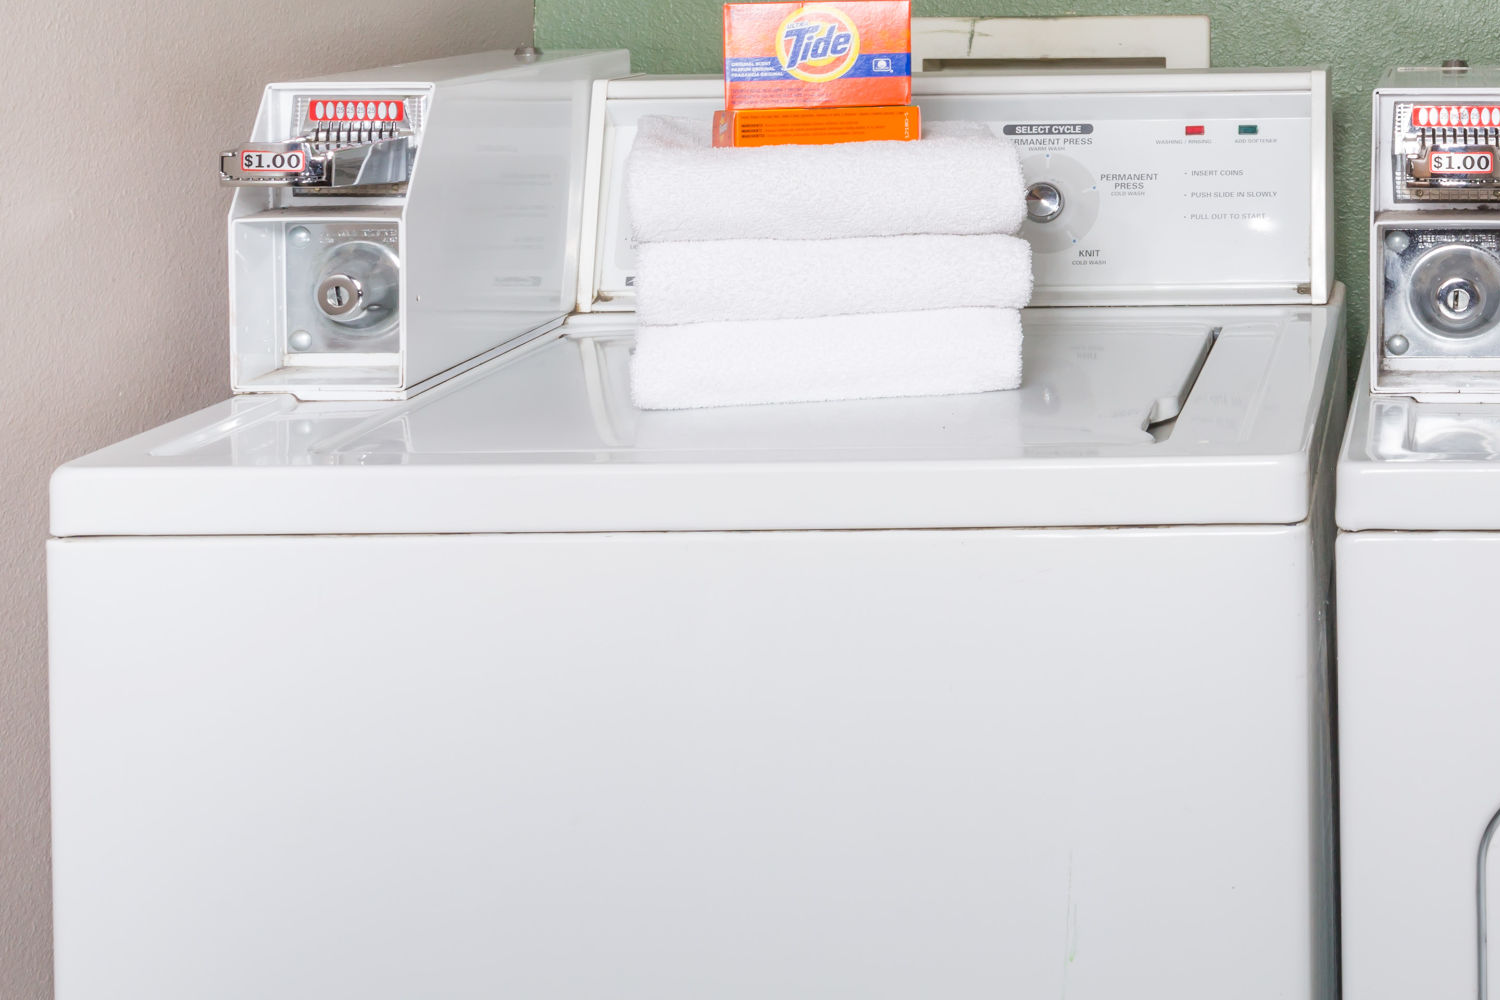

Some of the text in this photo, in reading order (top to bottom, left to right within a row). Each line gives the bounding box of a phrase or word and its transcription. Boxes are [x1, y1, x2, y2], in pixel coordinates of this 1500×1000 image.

[783, 23, 852, 71] Tide
[1015, 125, 1081, 134] SELECT CYCLE
[244, 154, 300, 169] $1.00
[1433, 155, 1490, 170] $1.00
[1100, 173, 1158, 181] PERMANENT
[1115, 182, 1144, 190] PRESS
